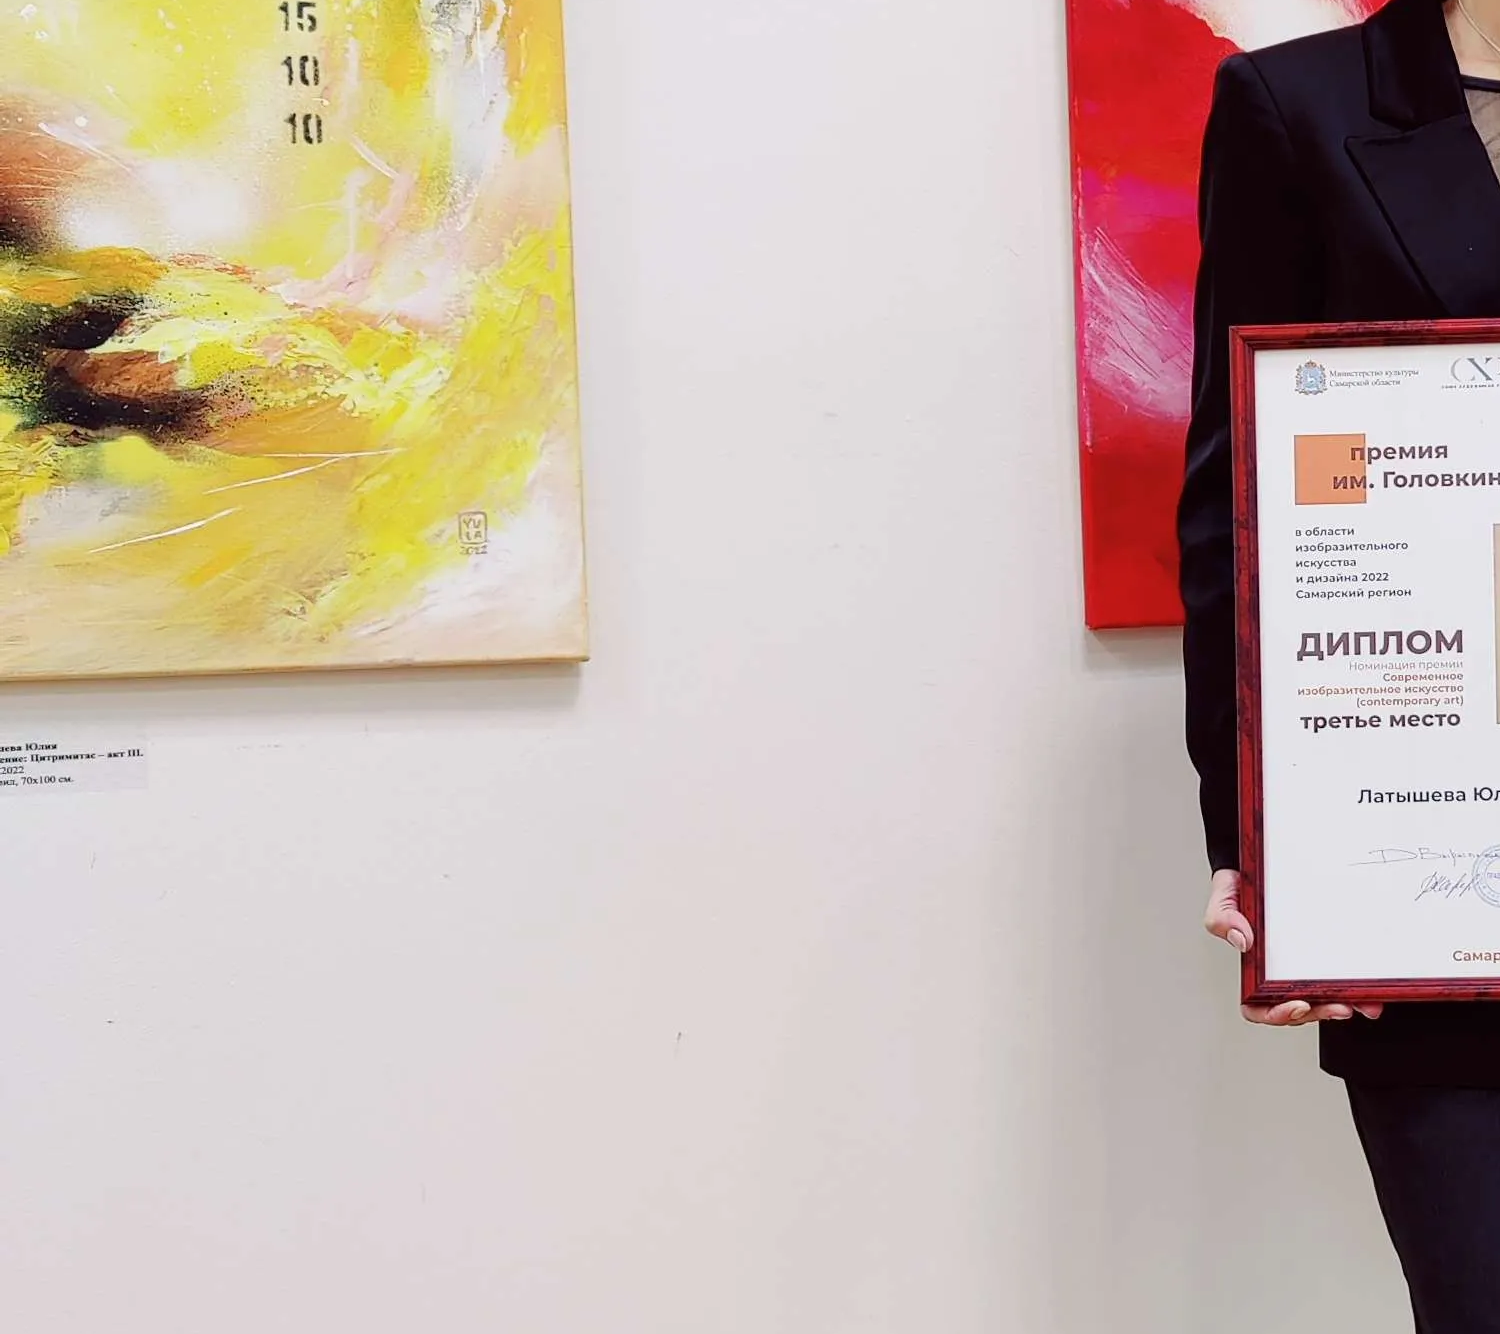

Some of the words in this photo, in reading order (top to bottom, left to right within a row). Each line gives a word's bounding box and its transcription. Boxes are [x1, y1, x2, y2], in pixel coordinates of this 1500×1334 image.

[278, 1, 318, 33] 15
[281, 55, 320, 87] 10
[284, 113, 323, 145] 10
[1329, 370, 1384, 379] Министерство
[1385, 369, 1419, 378] культуры
[1329, 379, 1369, 388] Самарской
[1371, 378, 1401, 386] области
[1350, 444, 1449, 464] премия
[1333, 475, 1375, 489] им.
[1305, 527, 1355, 536] области
[1295, 542, 1409, 553] изобразительного
[1295, 559, 1357, 569] искусства
[1307, 574, 1358, 584] дизайна
[1361, 572, 1390, 582] 2022
[1295, 588, 1364, 600] Самарский
[1368, 589, 1412, 599] регион
[1296, 630, 1464, 661] ДИПЛОМ
[1349, 661, 1416, 671] Номинация
[1419, 661, 1463, 671] премии
[1383, 673, 1464, 683] Современное
[1297, 685, 1401, 696] изобразительное
[1404, 685, 1464, 695] искусство
[1356, 696, 1440, 708] (contemporary
[1443, 695, 1464, 706] art)
[1299, 715, 1382, 733] третье
[1389, 713, 1461, 728] место
[25, 742, 58, 752] Юлия
[1357, 789, 1466, 804] Латышева
